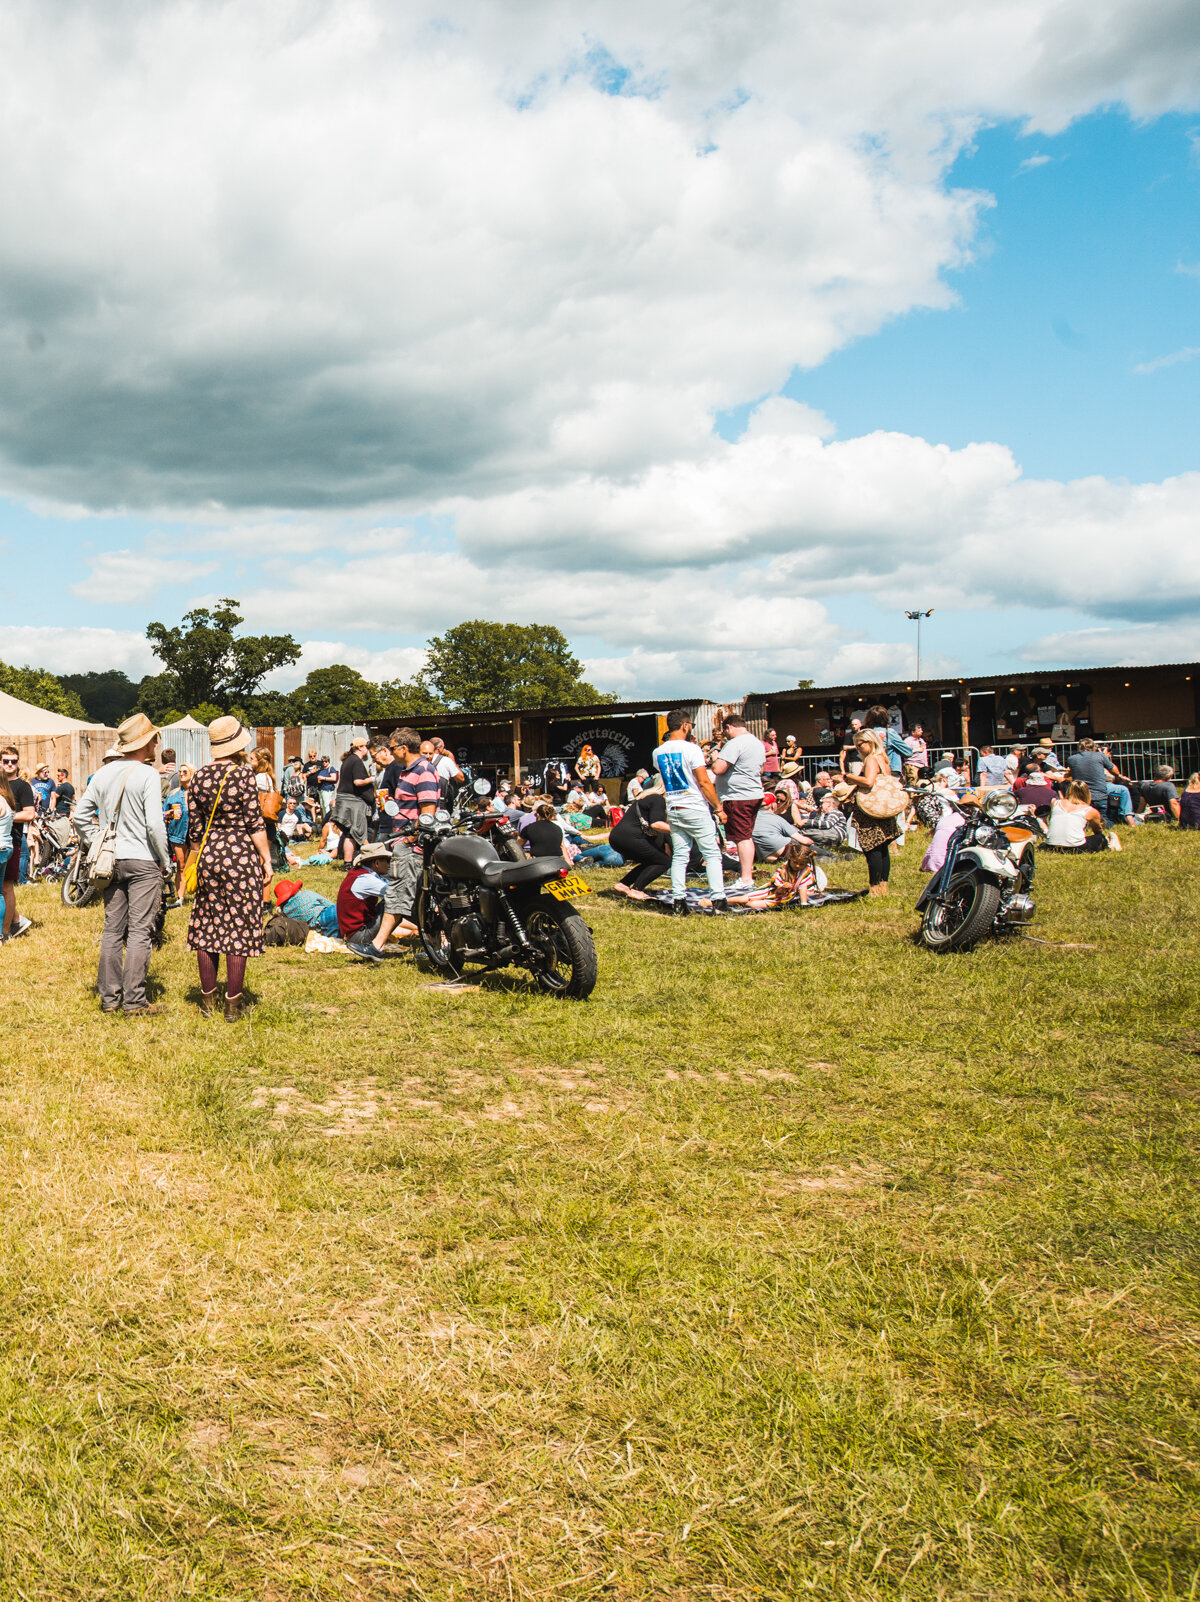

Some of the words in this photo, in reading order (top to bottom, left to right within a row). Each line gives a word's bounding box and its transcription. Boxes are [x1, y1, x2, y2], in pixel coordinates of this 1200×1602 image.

[562, 727, 636, 754] desertscene
[547, 877, 580, 892] GN07
[558, 886, 587, 899] MWA
